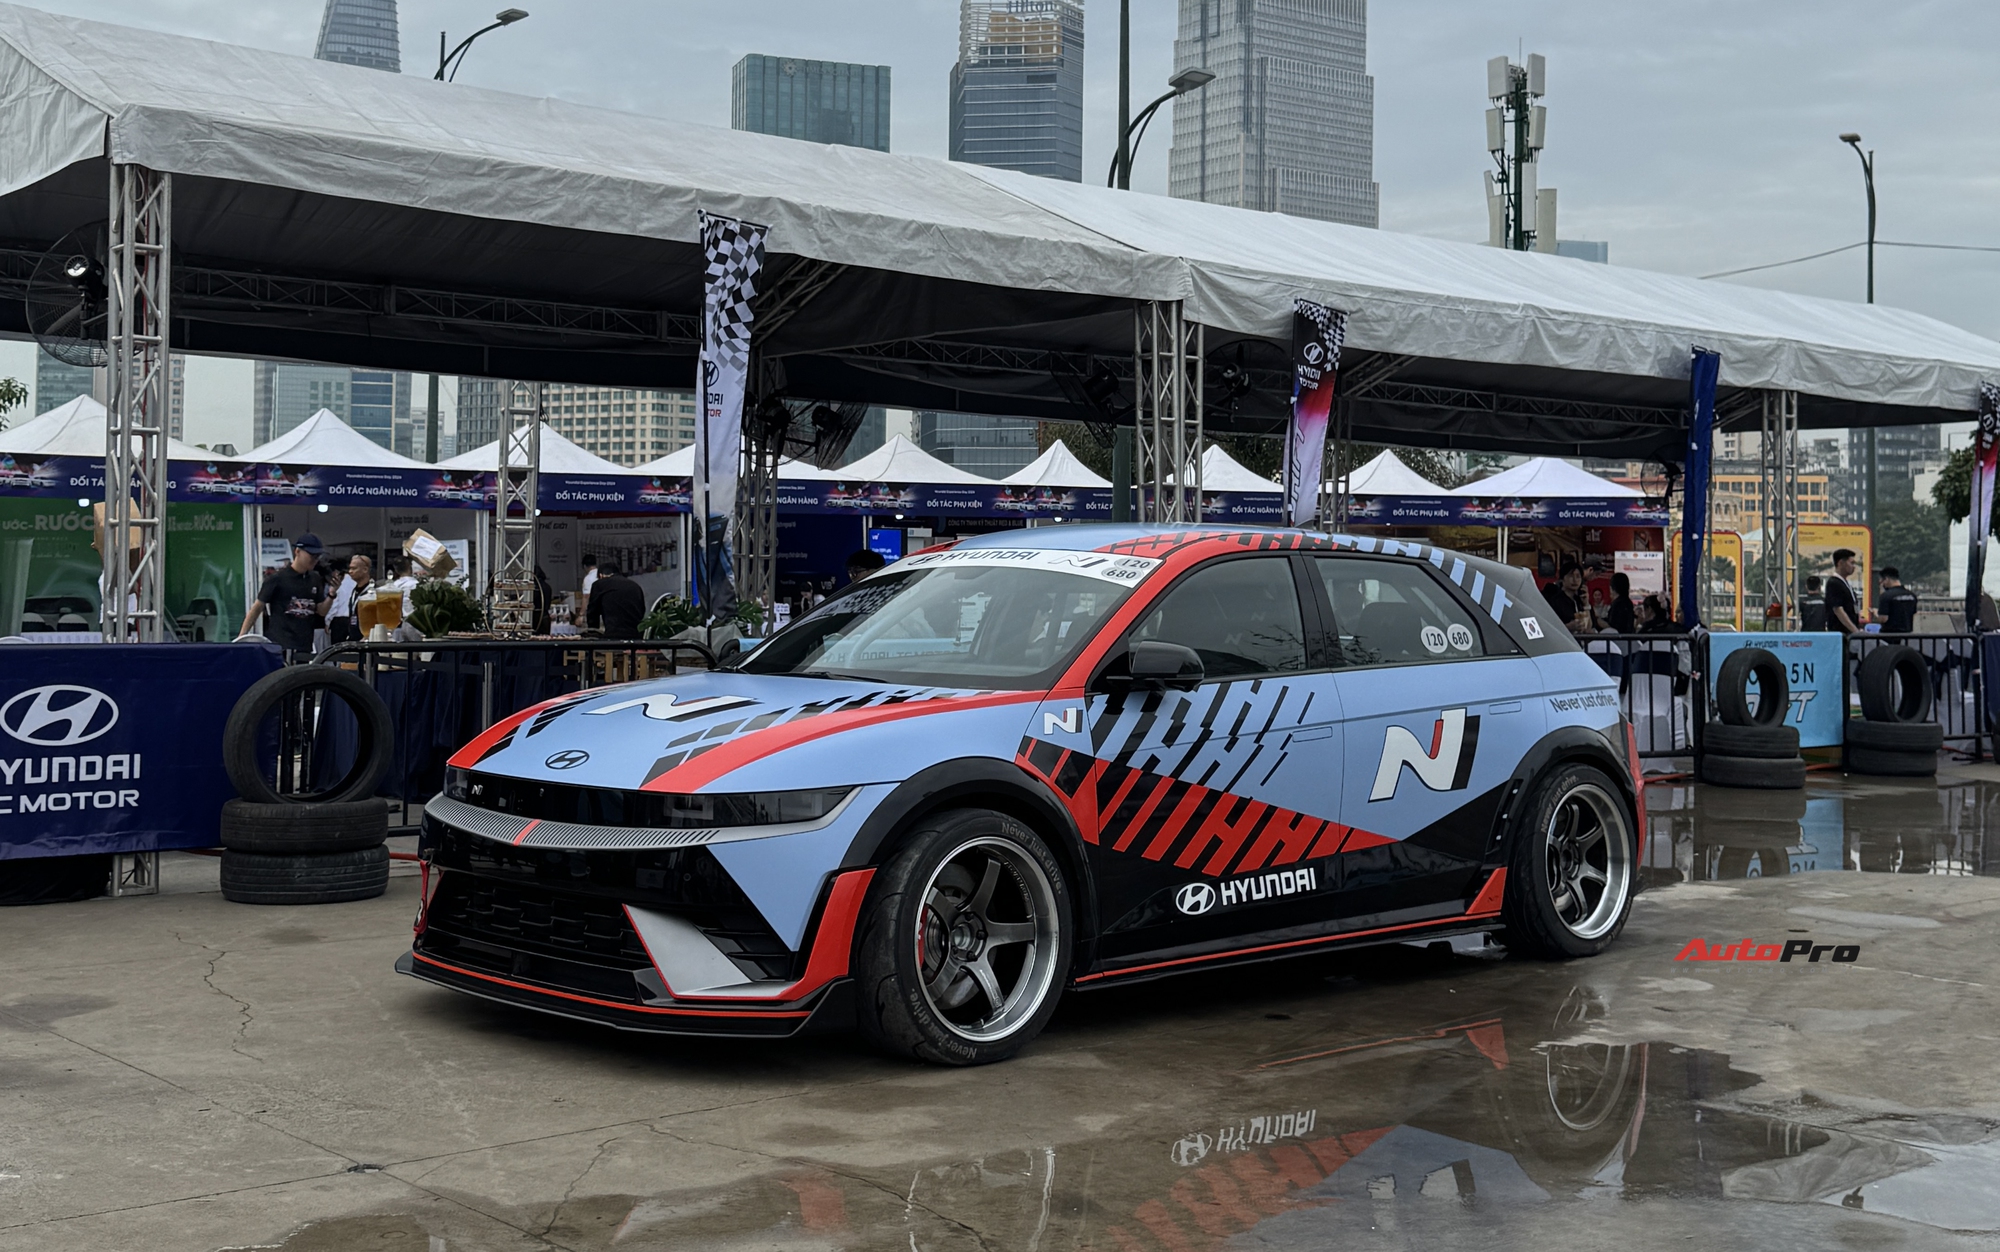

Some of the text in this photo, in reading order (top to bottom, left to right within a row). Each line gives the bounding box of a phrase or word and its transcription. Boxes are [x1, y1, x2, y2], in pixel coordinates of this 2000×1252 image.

[70, 475, 89, 486] ĐỐI
[91, 476, 106, 487] TÁ
[329, 484, 418, 496] ĐỐI TÁC NGÂN HÀNG
[556, 490, 624, 502] ĐỐI TÁC PHỤ KIỆN
[777, 496, 797, 504] NGÂN
[798, 496, 818, 505] HÀNG
[926, 499, 982, 509] ĐỐI TÁC PHỤ KIỆN
[1098, 502, 1108, 510] TÁC
[1393, 508, 1405, 516] ĐỐI
[1406, 508, 1418, 516] TÁC
[1434, 508, 1449, 517] KIỆN
[1559, 509, 1571, 518] ĐỐI
[1572, 510, 1585, 518] TÁC
[1600, 510, 1615, 518] KIỆN
[942, 552, 1108, 568] HYUNDAI N
[1121, 560, 1150, 568] 120
[1107, 569, 1137, 579] 680
[1426, 632, 1468, 646] 120 680
[1549, 691, 1618, 713] Never just drive.
[1044, 708, 1083, 734] N
[1368, 708, 1480, 803] N
[0, 754, 141, 785] YUNDAI
[20, 790, 139, 813] MOTOR
[1001, 822, 1030, 842] Never
[1030, 838, 1047, 861] just
[1044, 858, 1062, 895] drive.
[1220, 867, 1316, 906] HYUNDAI
[909, 987, 934, 1031] drive.
[950, 1042, 977, 1059] Never
